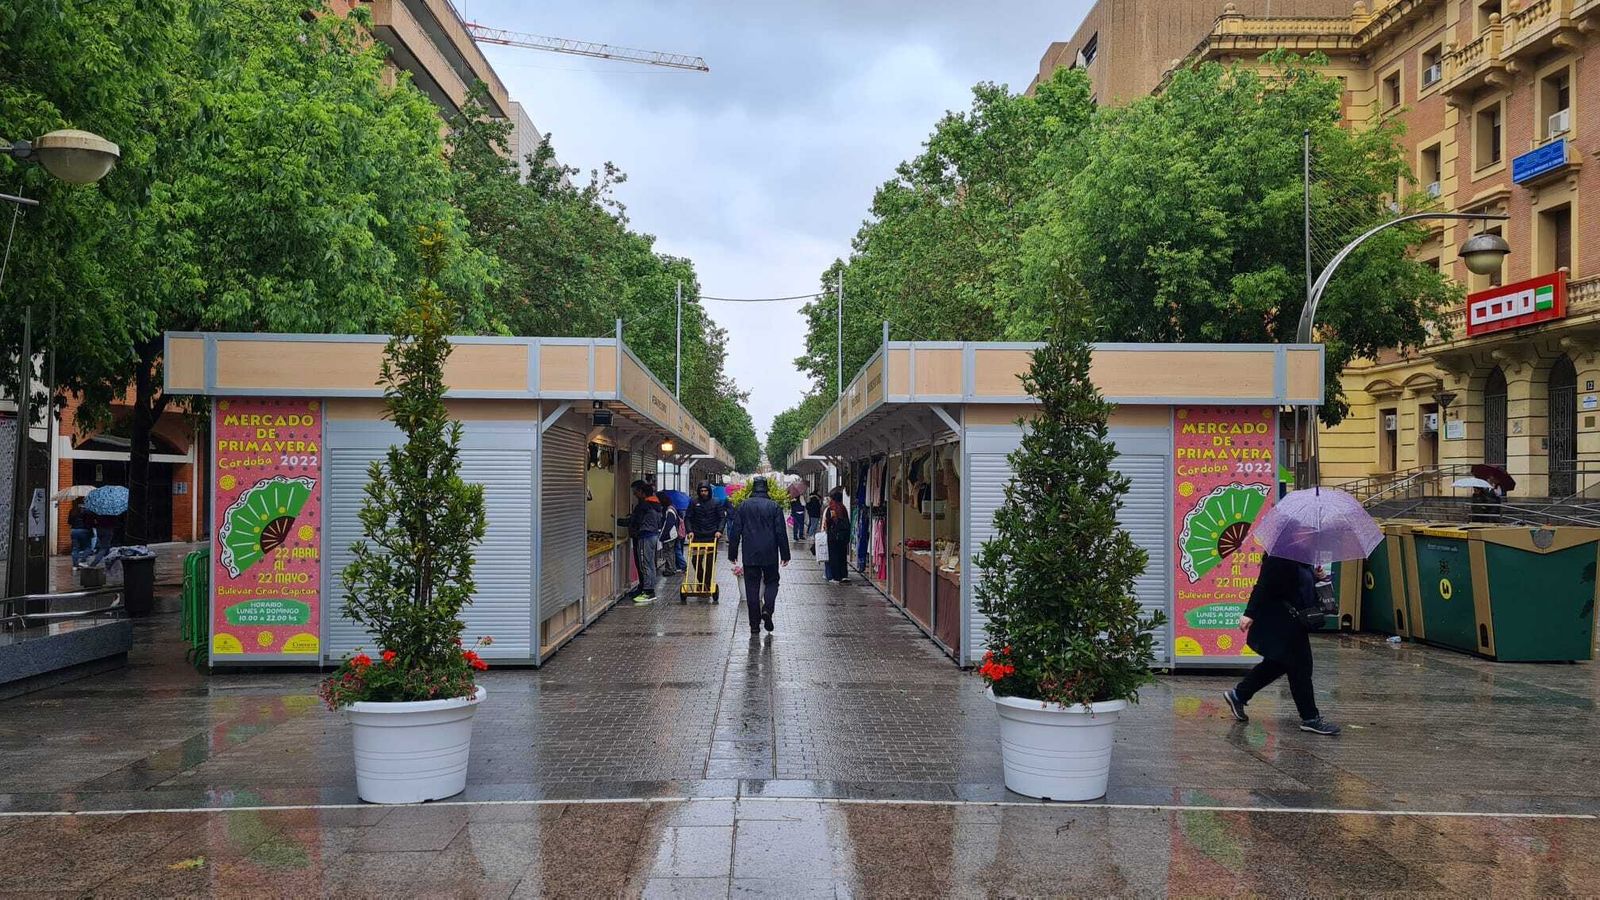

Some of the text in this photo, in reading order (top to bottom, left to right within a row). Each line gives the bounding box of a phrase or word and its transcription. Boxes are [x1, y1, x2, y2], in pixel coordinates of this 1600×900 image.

[224, 415, 314, 426] MERCADO
[256, 428, 276, 439] DE
[1182, 423, 1268, 434] MERCADO
[218, 441, 318, 452] PRIMAVERA
[1213, 436, 1232, 446] DE
[1177, 448, 1272, 459] PRIMAVERA
[280, 456, 318, 466] 2022
[1236, 463, 1272, 473] 2022
[275, 547, 319, 559] 22 ABRIL
[1231, 552, 1245, 563] 22
[258, 572, 309, 584] 22 MAYO
[1216, 577, 1258, 588] 22 MAY
[218, 586, 253, 595] Bulevar
[255, 587, 279, 595] Gran
[1214, 590, 1237, 599] Gran
